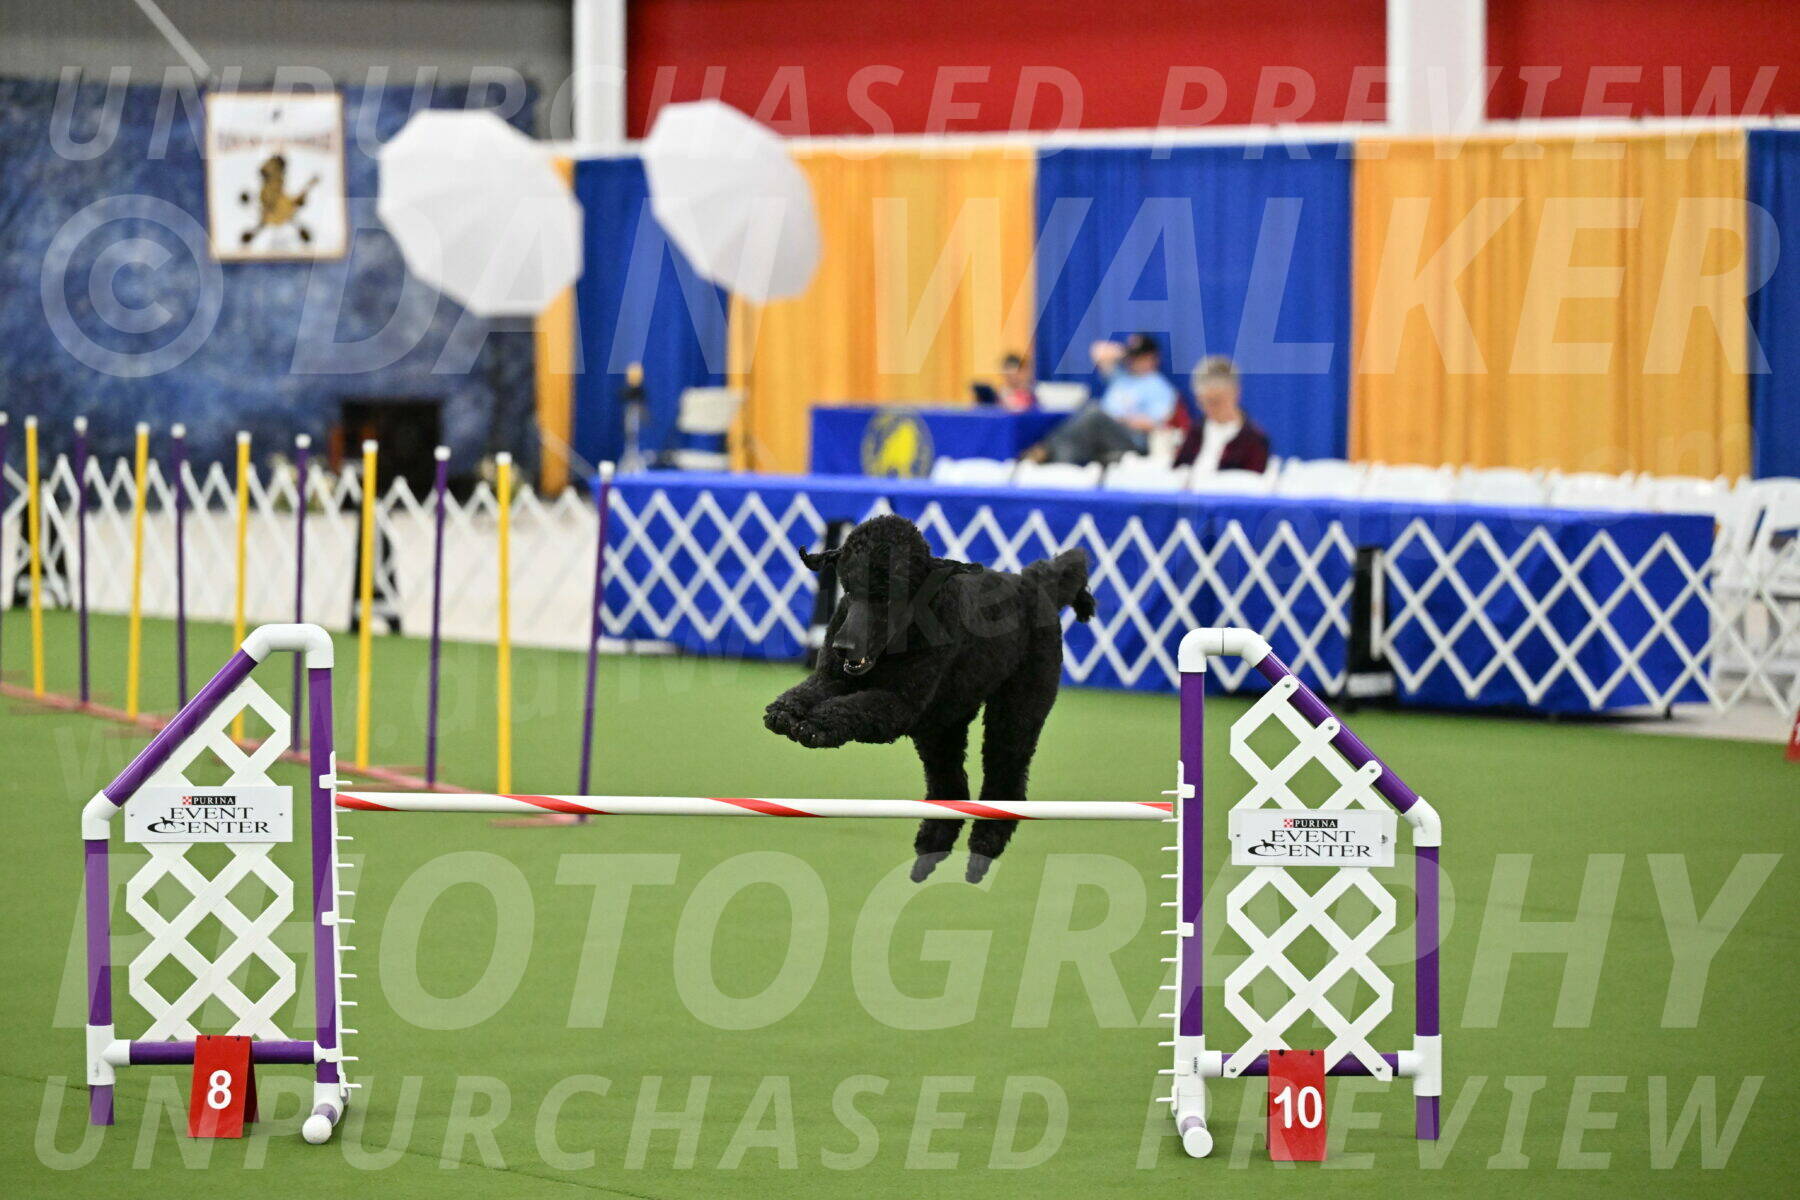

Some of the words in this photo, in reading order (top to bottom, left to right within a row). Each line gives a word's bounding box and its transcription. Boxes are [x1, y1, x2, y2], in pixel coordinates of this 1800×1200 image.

[193, 796, 236, 805] PURINA
[170, 807, 254, 819] EVENT
[147, 820, 271, 834] CENTER
[1295, 819, 1338, 828] PURINA
[1270, 830, 1356, 843] EVENT
[1247, 844, 1373, 857] CENTER
[207, 1070, 232, 1110] 8
[1273, 1085, 1323, 1129] 10
